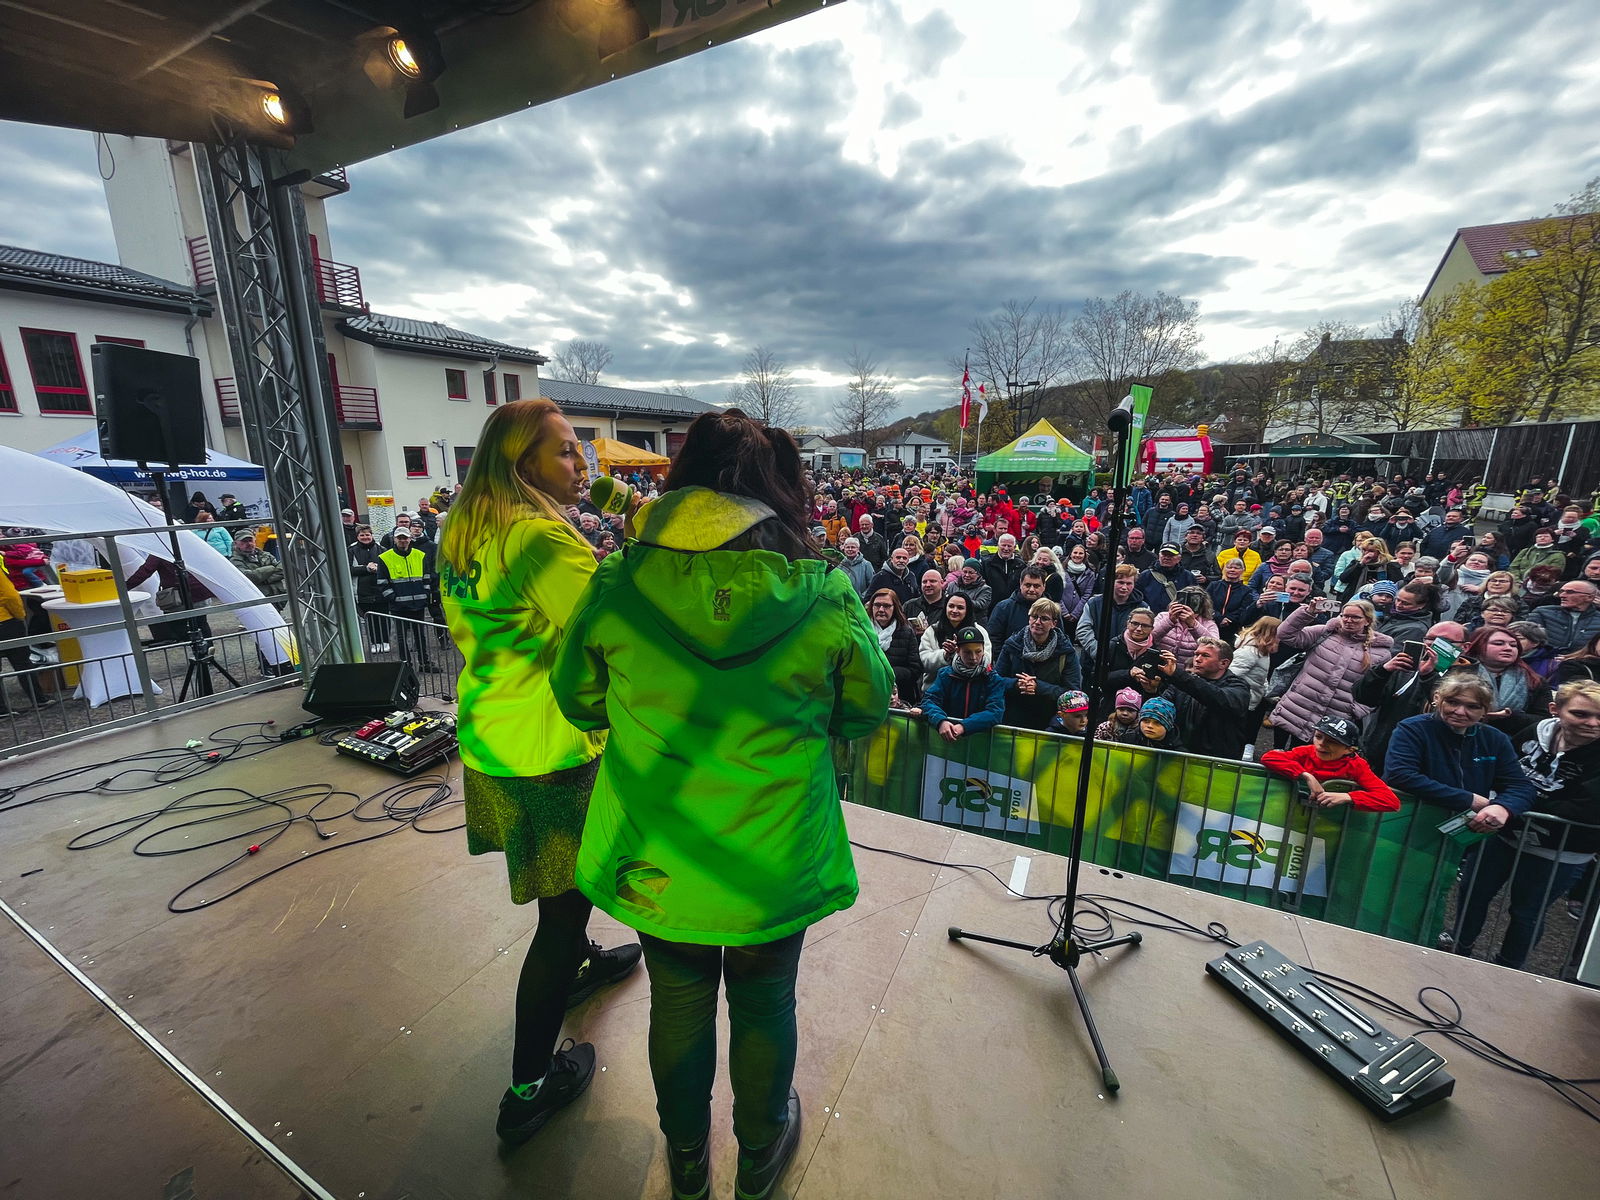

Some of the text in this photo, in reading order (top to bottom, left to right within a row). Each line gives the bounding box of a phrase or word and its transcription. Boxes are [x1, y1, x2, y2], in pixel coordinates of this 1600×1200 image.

[1023, 439, 1048, 448] PSR
[134, 469, 227, 479] w.wg-hot.de
[606, 492, 625, 513] PSR
